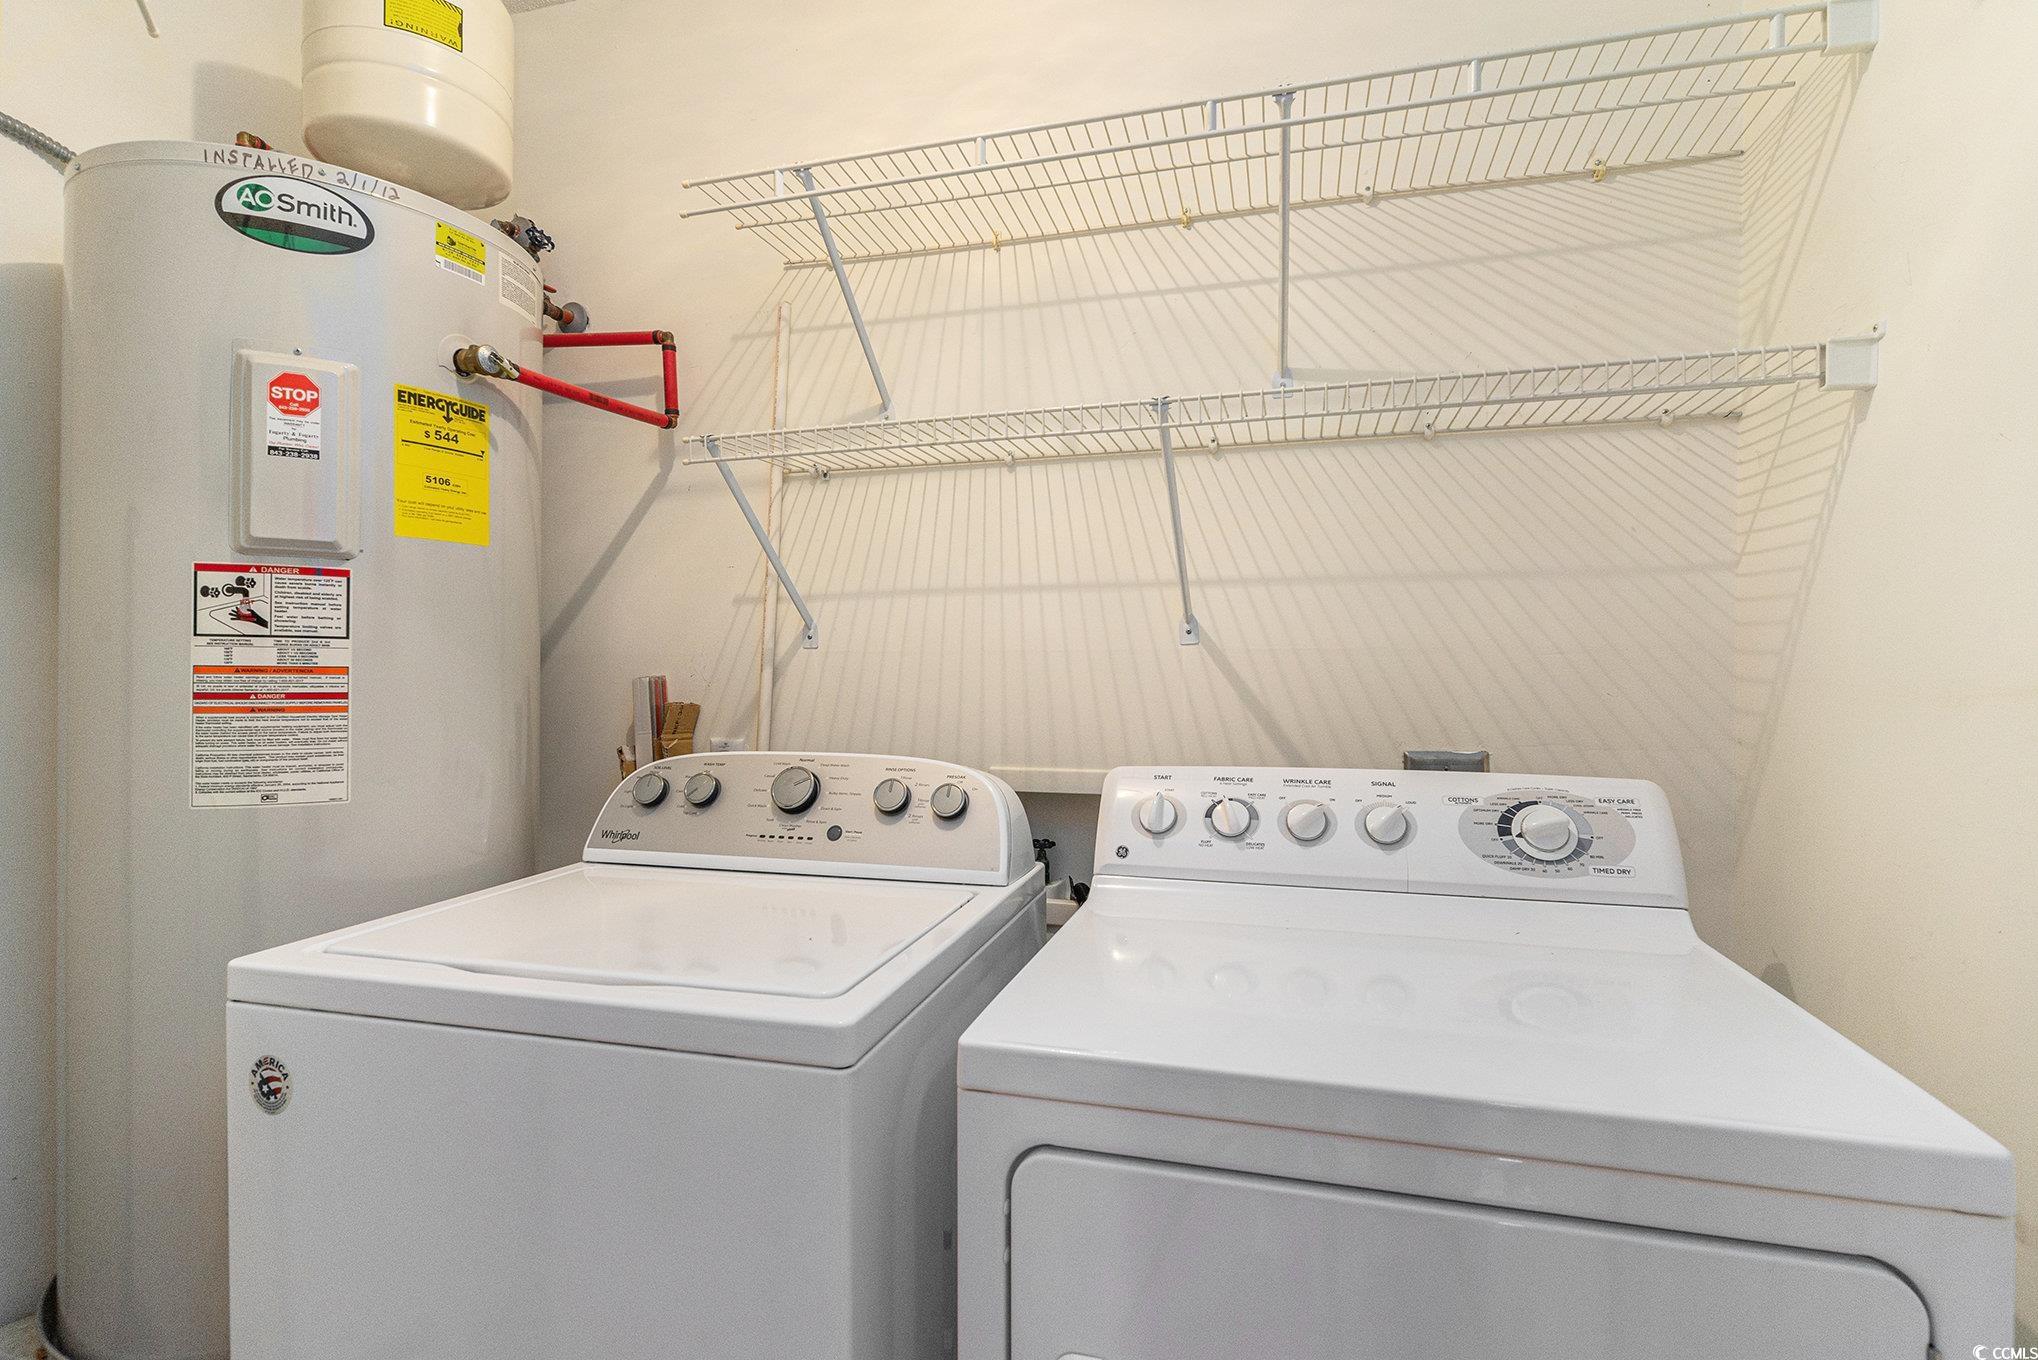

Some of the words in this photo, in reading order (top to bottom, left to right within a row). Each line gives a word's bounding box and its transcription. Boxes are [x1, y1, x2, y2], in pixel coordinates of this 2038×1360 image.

[390, 18, 458, 47] WARNING!
[203, 149, 314, 180] INSTALLED
[271, 386, 318, 402] STOP
[434, 429, 459, 444] 544
[425, 475, 451, 486] 5106
[260, 566, 300, 574] DANGER
[600, 829, 641, 844] Whirlpool
[1592, 867, 1615, 875] TIMED
[251, 1056, 289, 1081] AMERICA
